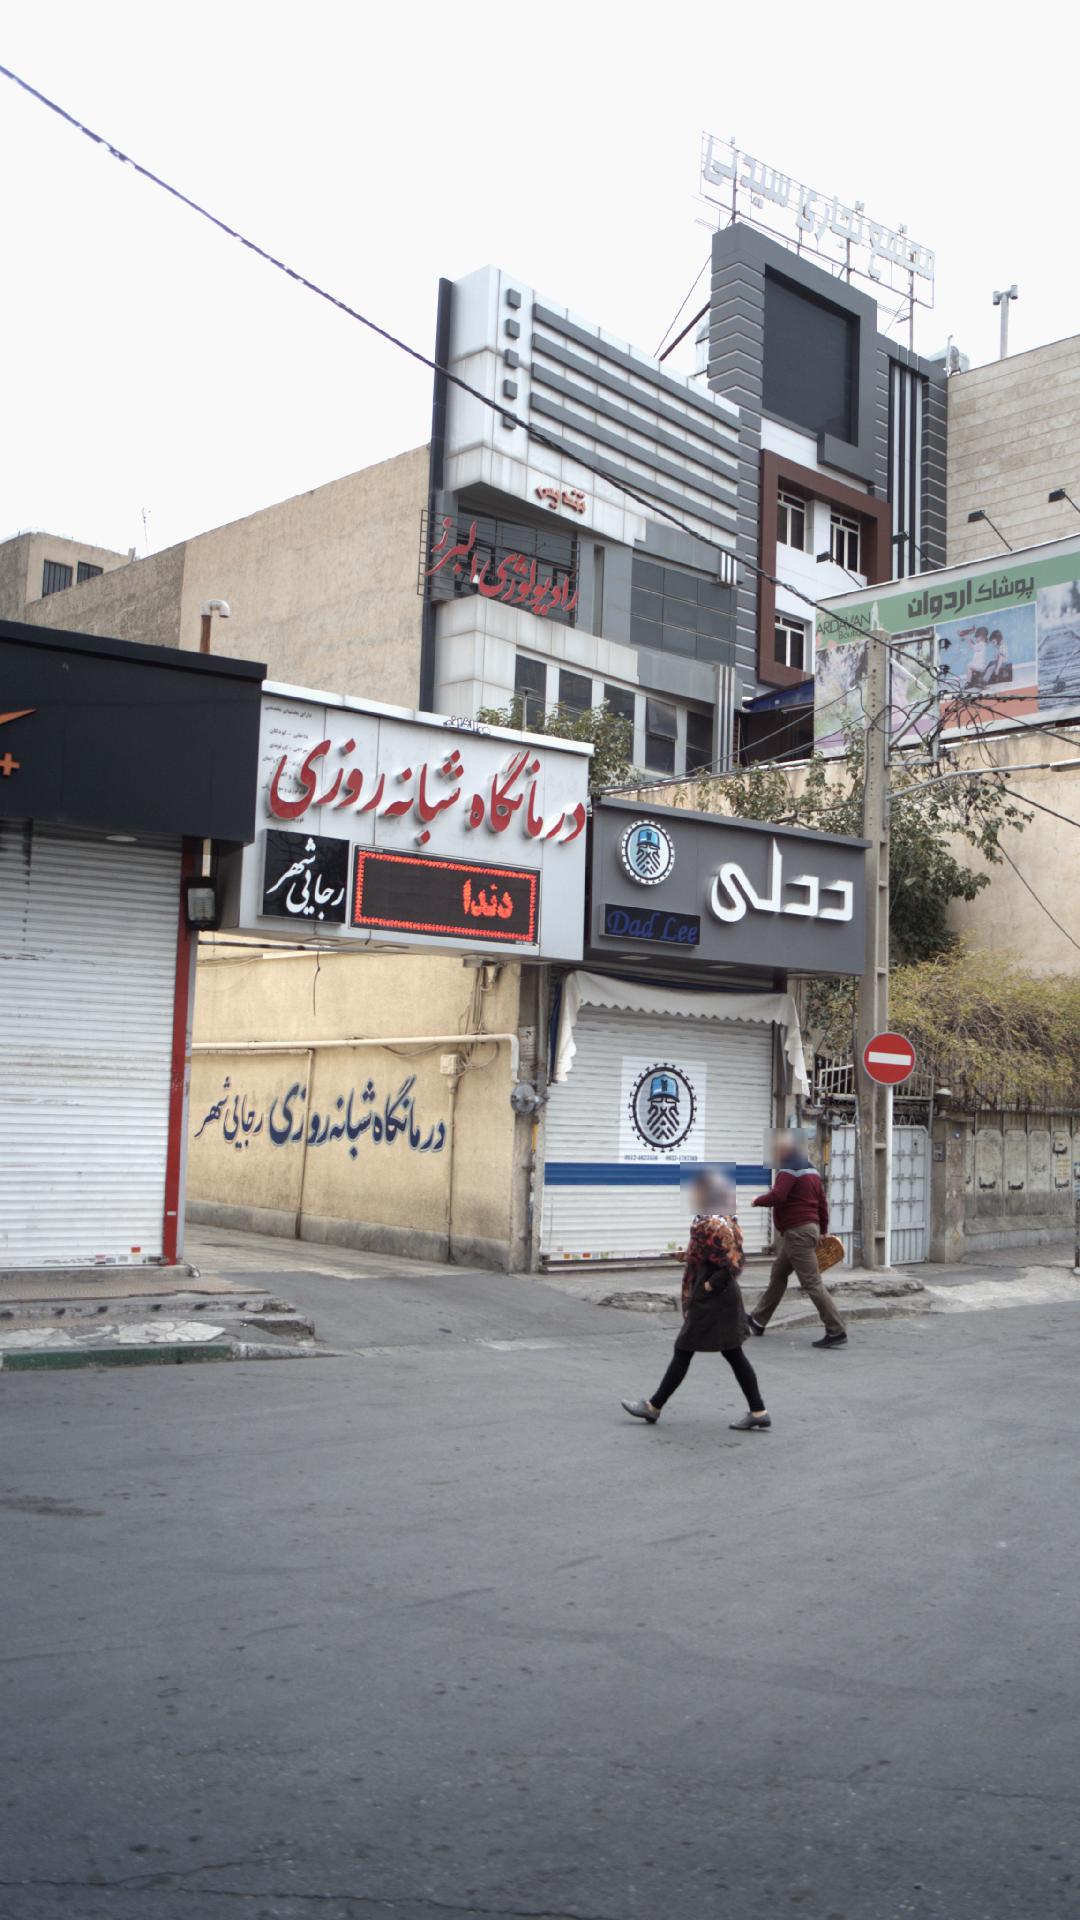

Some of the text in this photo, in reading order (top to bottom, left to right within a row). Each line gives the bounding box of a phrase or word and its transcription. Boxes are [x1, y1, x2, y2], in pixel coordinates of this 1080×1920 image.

[796, 184, 865, 250] تجاری
[867, 222, 935, 281] مجتمع
[424, 517, 580, 616] رادیولوژی البرز
[907, 576, 1035, 619] پوشاک اردوان
[468, 750, 586, 844] درمانگاه
[265, 837, 316, 894] شهر
[710, 836, 854, 923] ددلی
[607, 910, 698, 945] Dad Lee
[193, 1075, 230, 1138] شهر
[371, 1074, 446, 1153] درمانگاه
